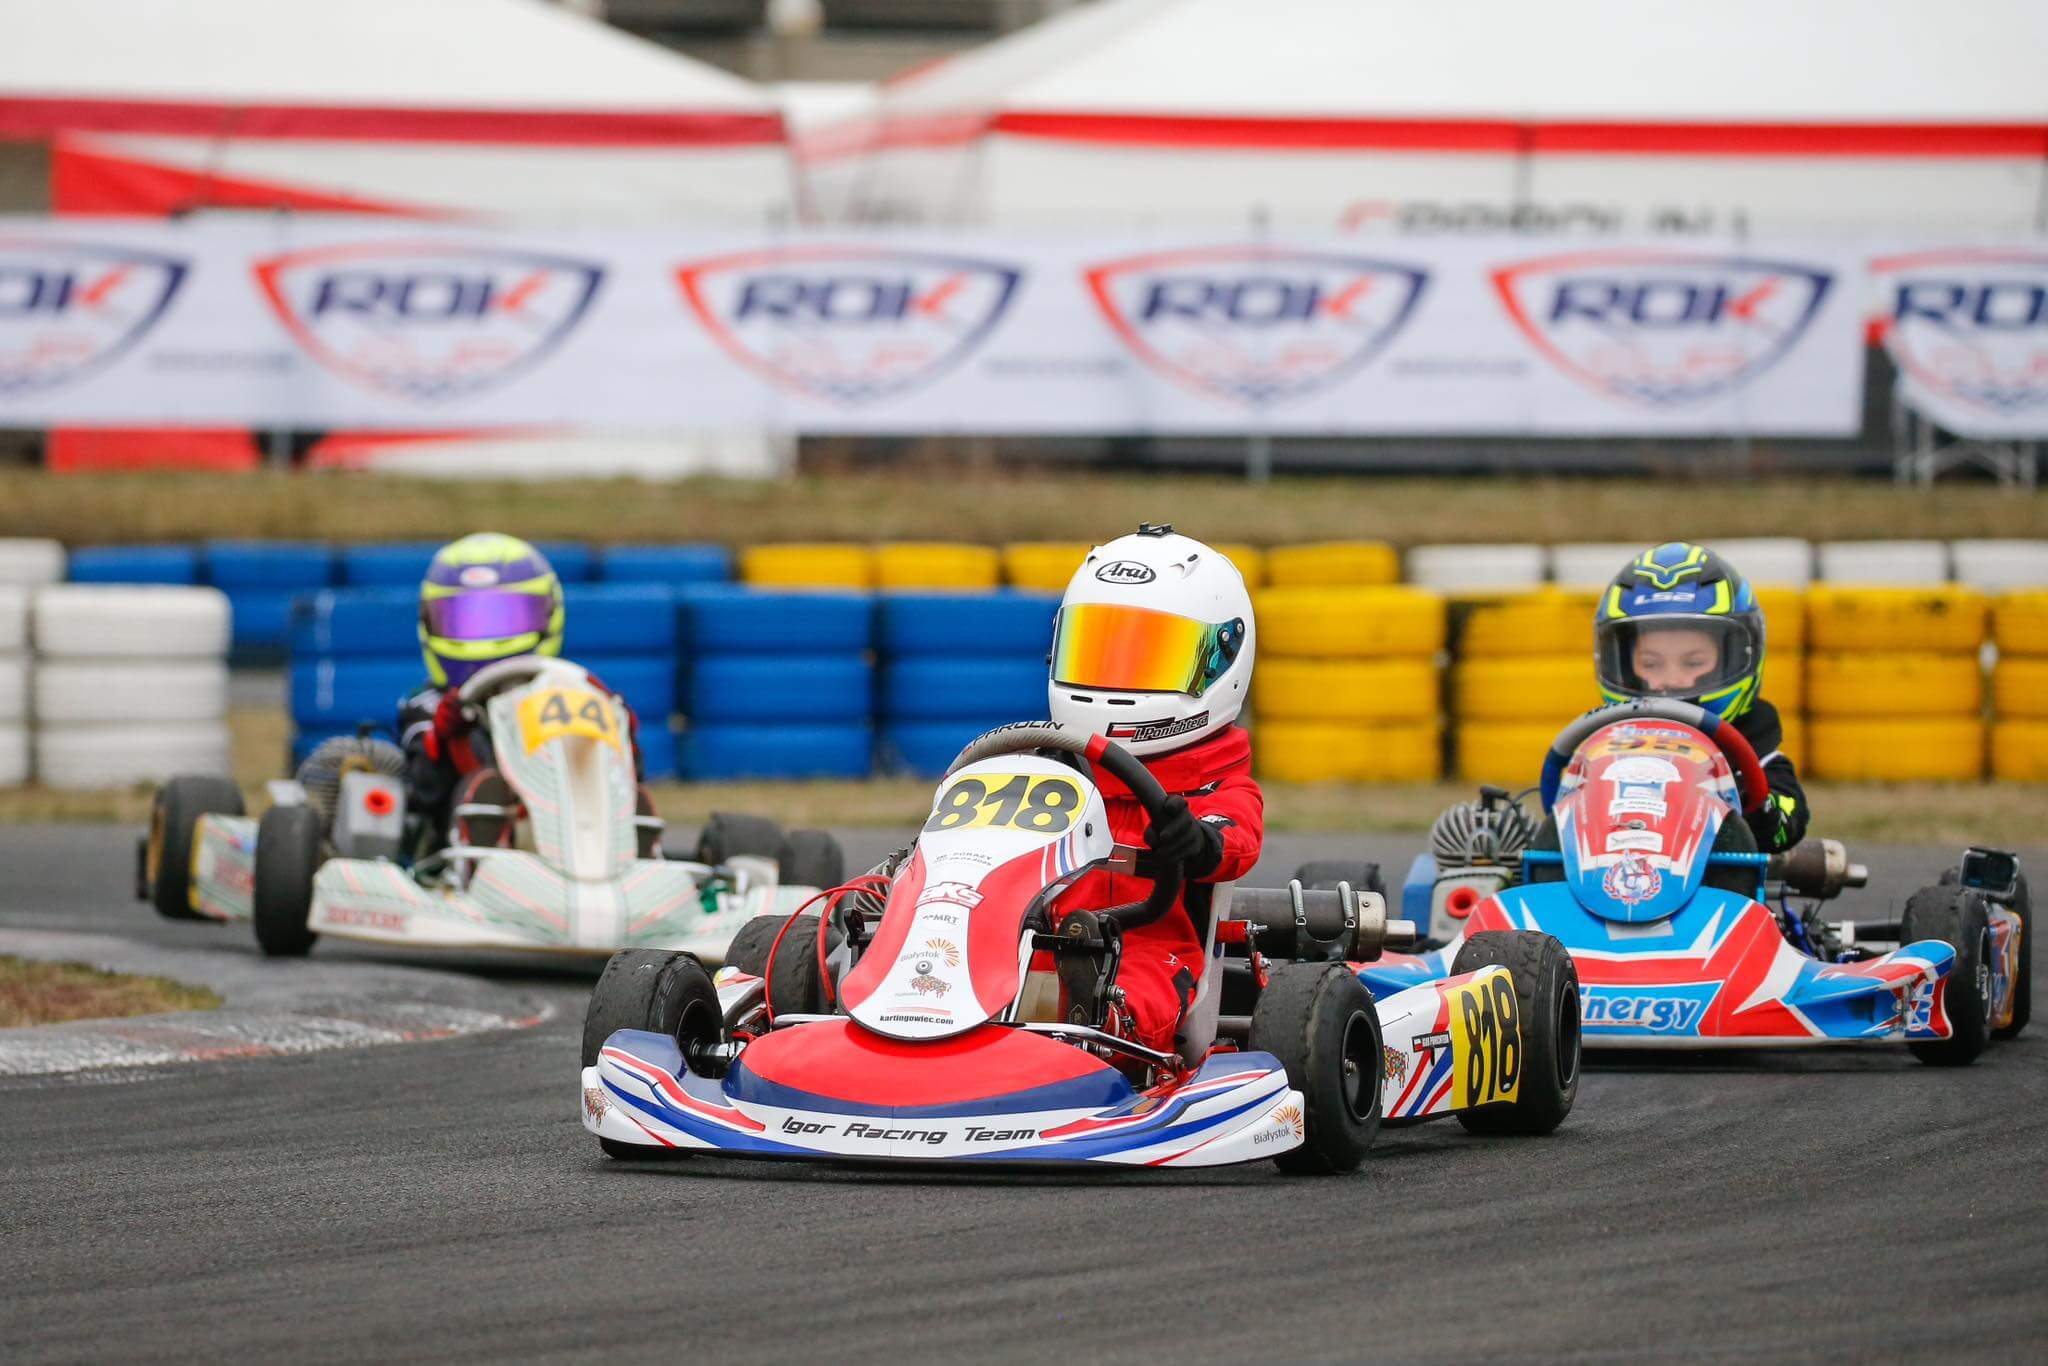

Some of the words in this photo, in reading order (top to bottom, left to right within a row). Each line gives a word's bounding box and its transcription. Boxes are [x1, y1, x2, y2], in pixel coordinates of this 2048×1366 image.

[311, 267, 552, 326] ROK
[735, 271, 968, 328] ROK
[1141, 273, 1375, 330] ROK
[1550, 275, 1780, 331] ROK
[1099, 562, 1149, 580] Arai
[1634, 591, 1696, 606] LS2
[540, 694, 609, 733] 44
[924, 775, 1079, 832] 818
[1461, 975, 1520, 1107] 818
[782, 1116, 837, 1135] Igor
[843, 1123, 948, 1145] Racing
[964, 1126, 1036, 1142] Team
